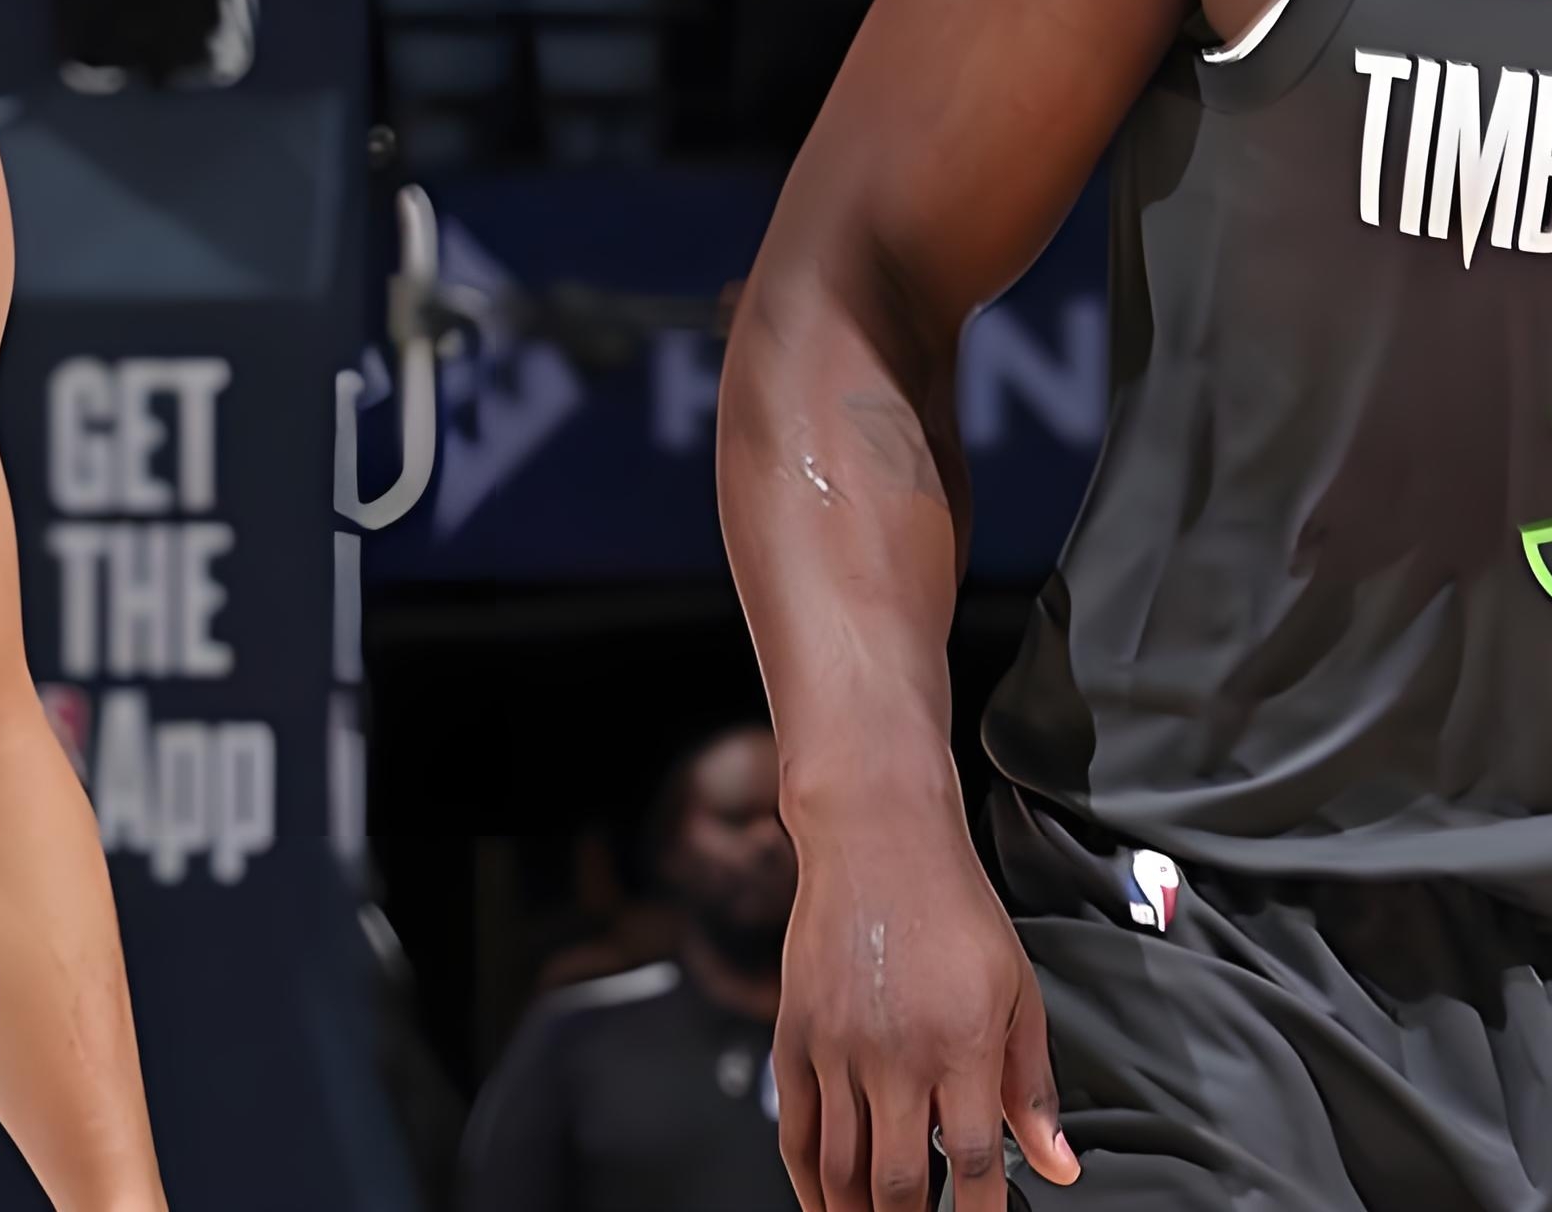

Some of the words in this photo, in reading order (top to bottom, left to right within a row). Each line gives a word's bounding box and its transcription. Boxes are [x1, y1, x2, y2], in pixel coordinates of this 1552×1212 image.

[47, 355, 233, 515] GET
[43, 521, 236, 679] THE
[98, 685, 277, 886] App
